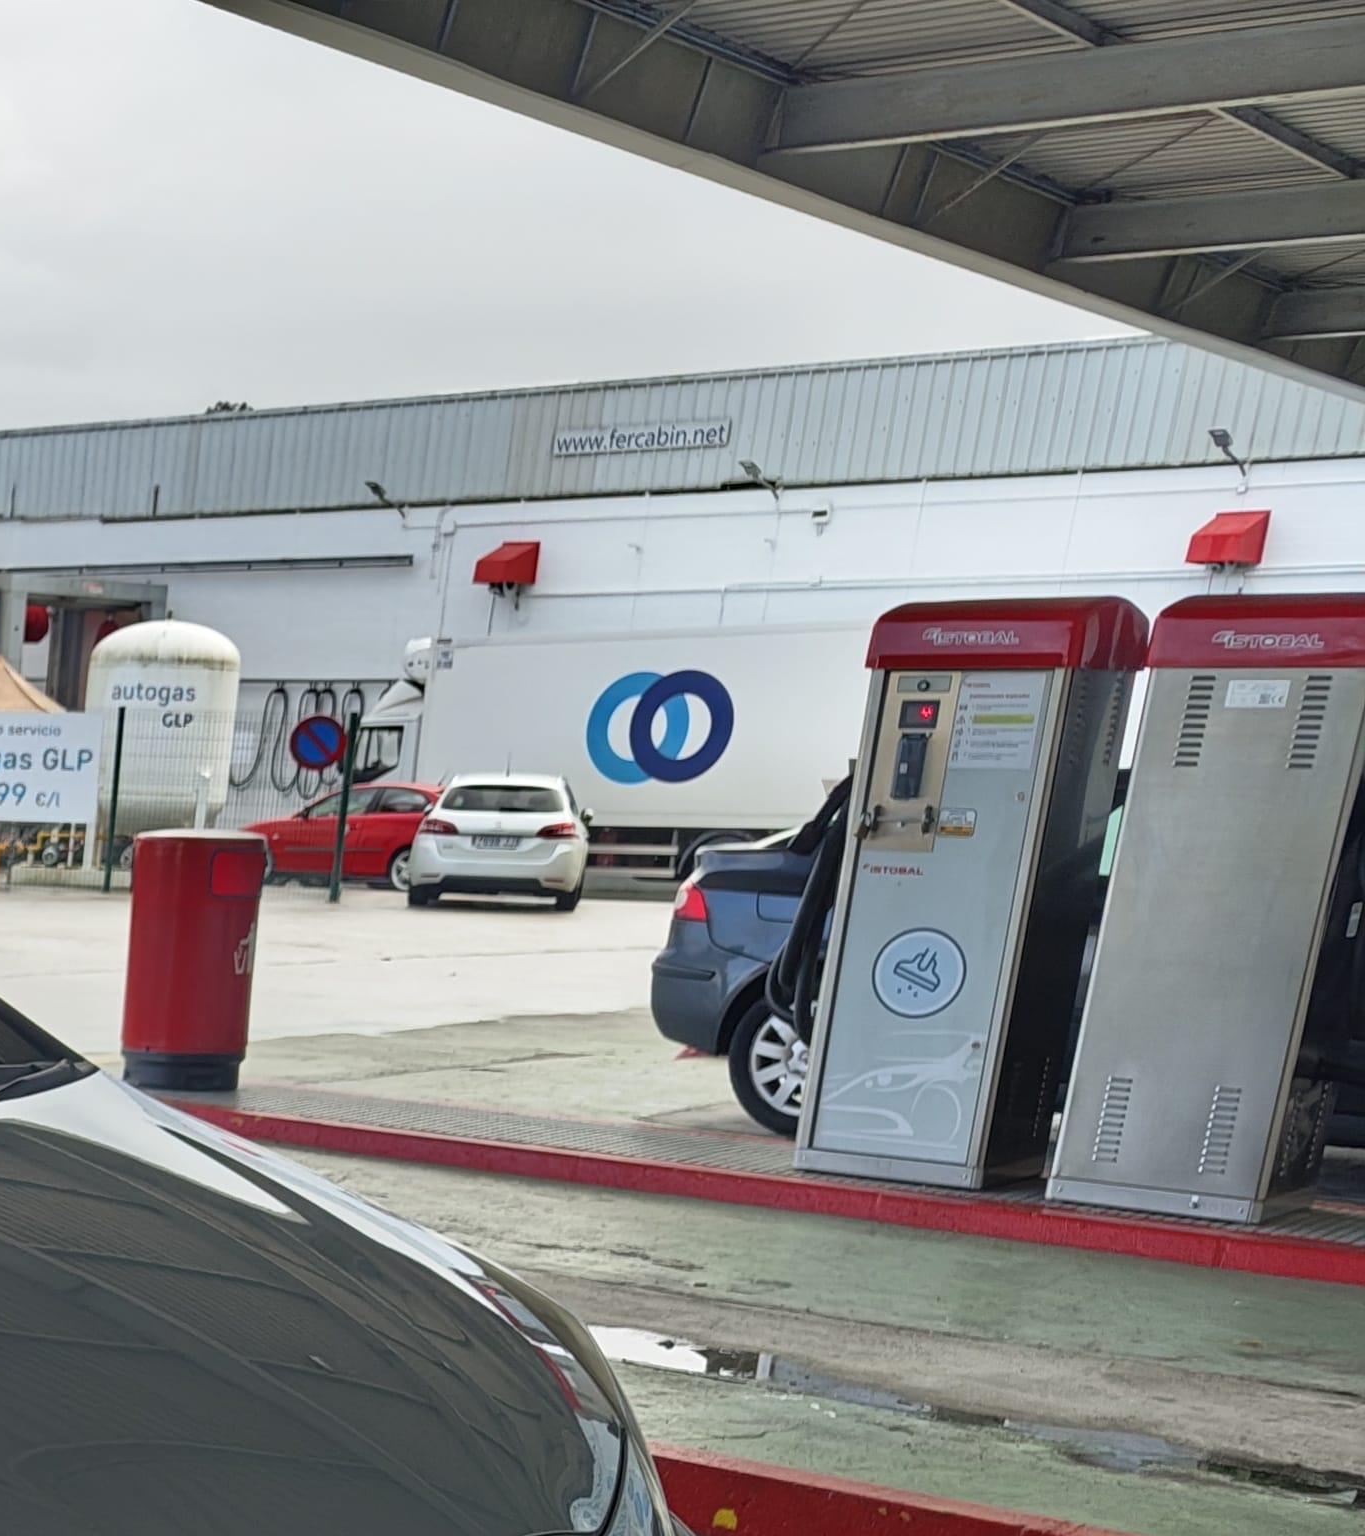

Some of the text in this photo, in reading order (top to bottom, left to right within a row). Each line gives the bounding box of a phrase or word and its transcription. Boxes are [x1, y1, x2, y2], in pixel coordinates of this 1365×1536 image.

[556, 424, 726, 453] www.fercabin.net
[111, 683, 197, 707] autogas
[7, 724, 62, 738] servicio
[161, 712, 194, 728] GLP
[42, 747, 94, 772] GLP
